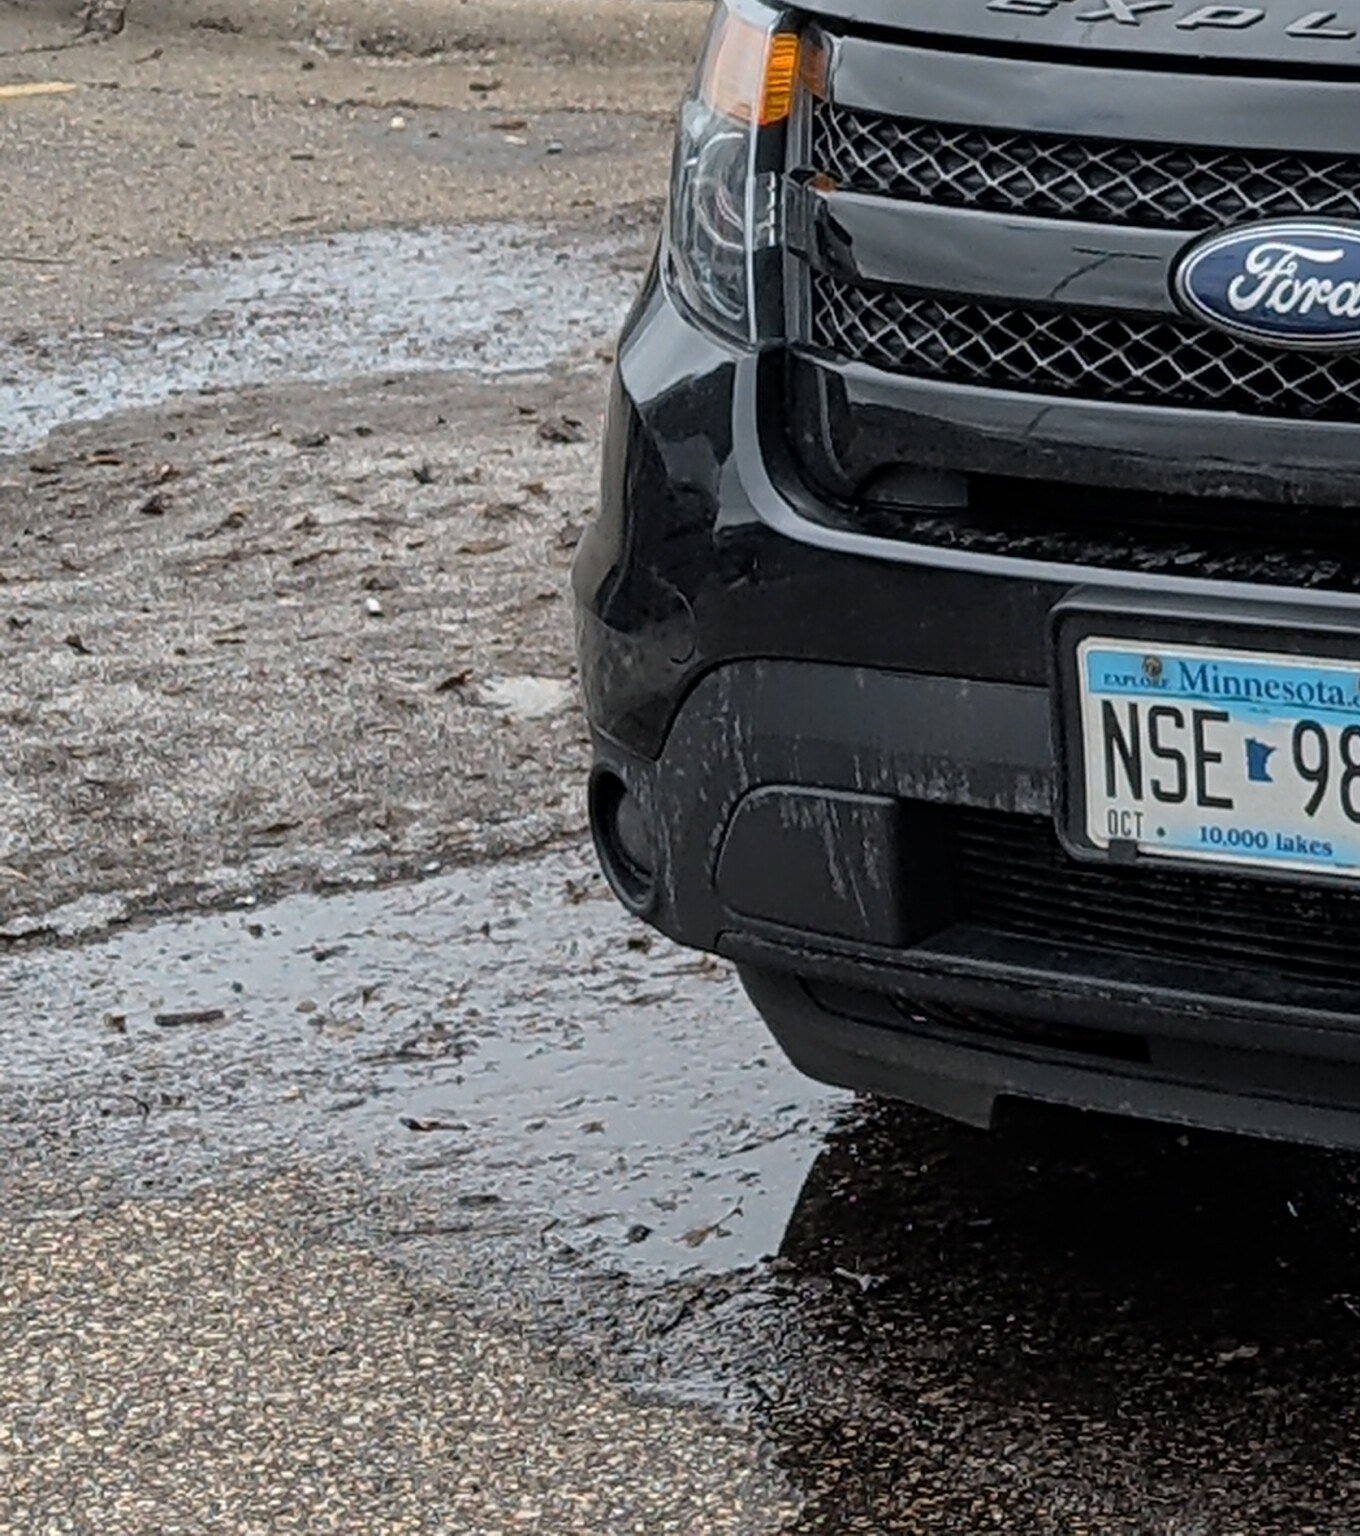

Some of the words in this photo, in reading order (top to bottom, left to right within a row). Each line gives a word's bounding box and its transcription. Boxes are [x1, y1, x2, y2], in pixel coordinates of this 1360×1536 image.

[1101, 699, 1234, 811] NSE
[1107, 809, 1144, 838] OCT
[1275, 832, 1334, 857] lakes
